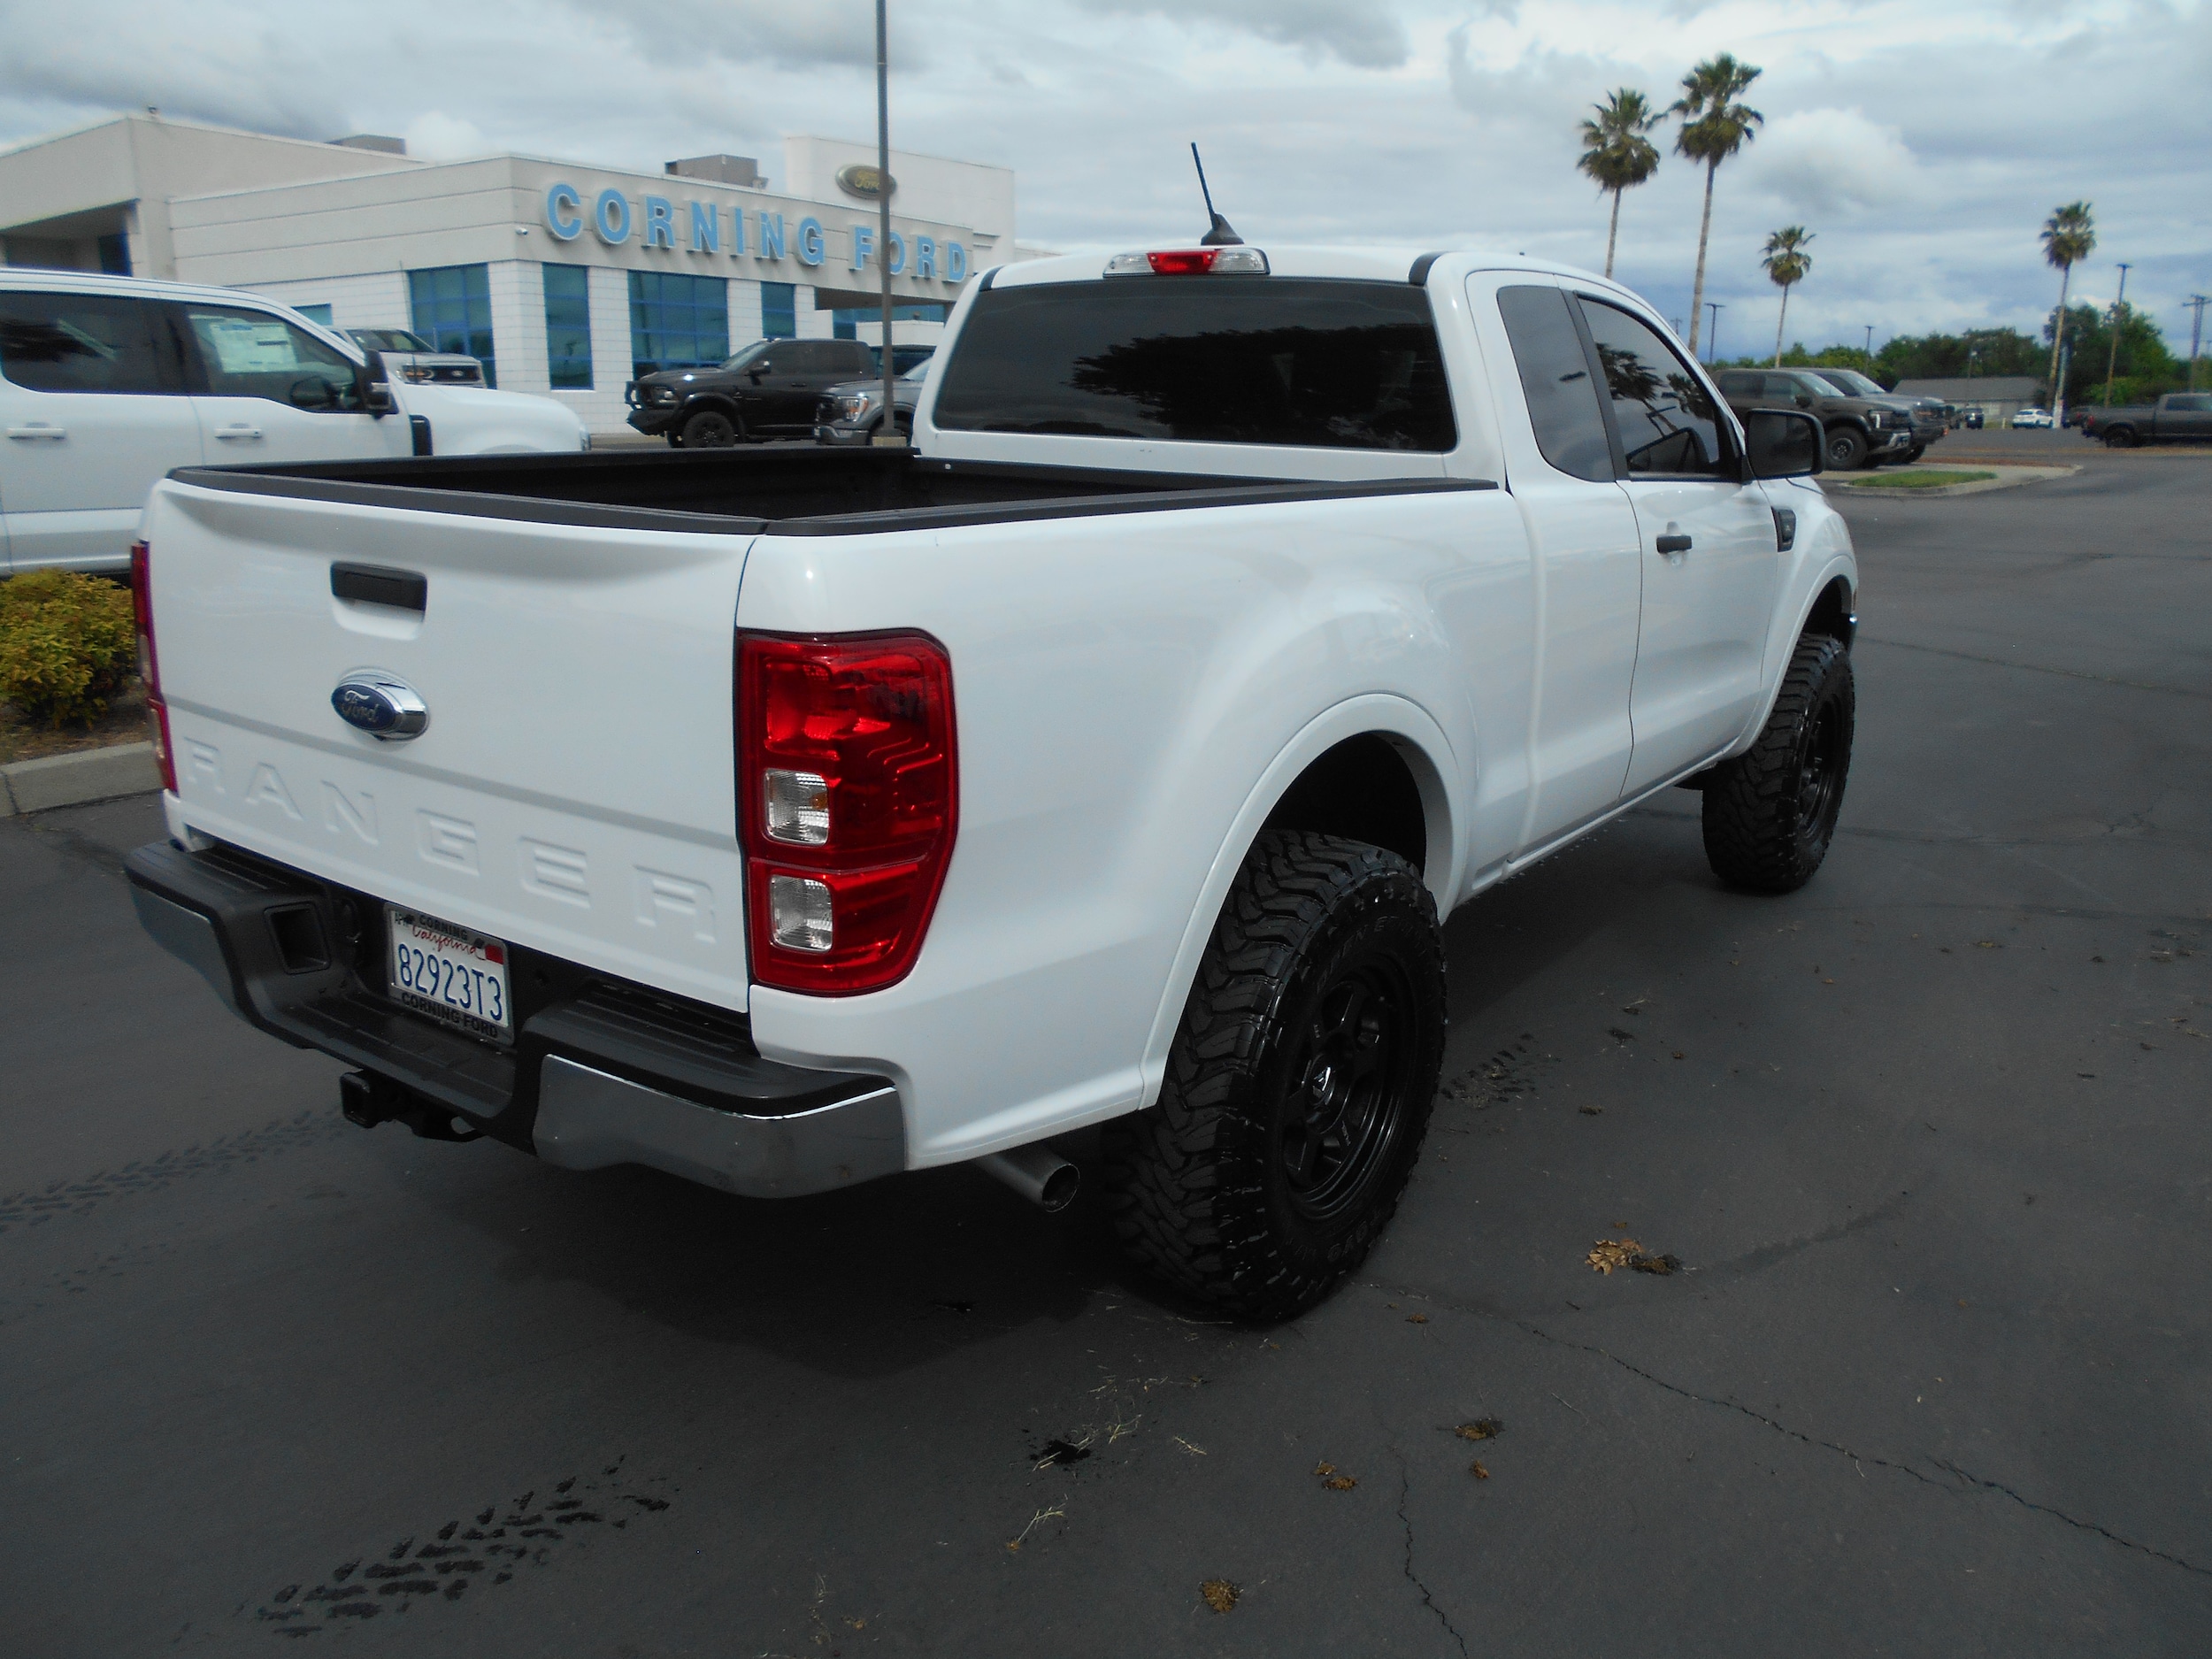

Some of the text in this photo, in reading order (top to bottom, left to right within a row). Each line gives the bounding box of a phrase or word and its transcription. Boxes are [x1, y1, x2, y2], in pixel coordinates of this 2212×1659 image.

[542, 183, 967, 283] CORNING FORD
[183, 736, 717, 944] RANGER
[398, 943, 503, 1021] 82923T3
[402, 992, 498, 1039] CORNING FORD
